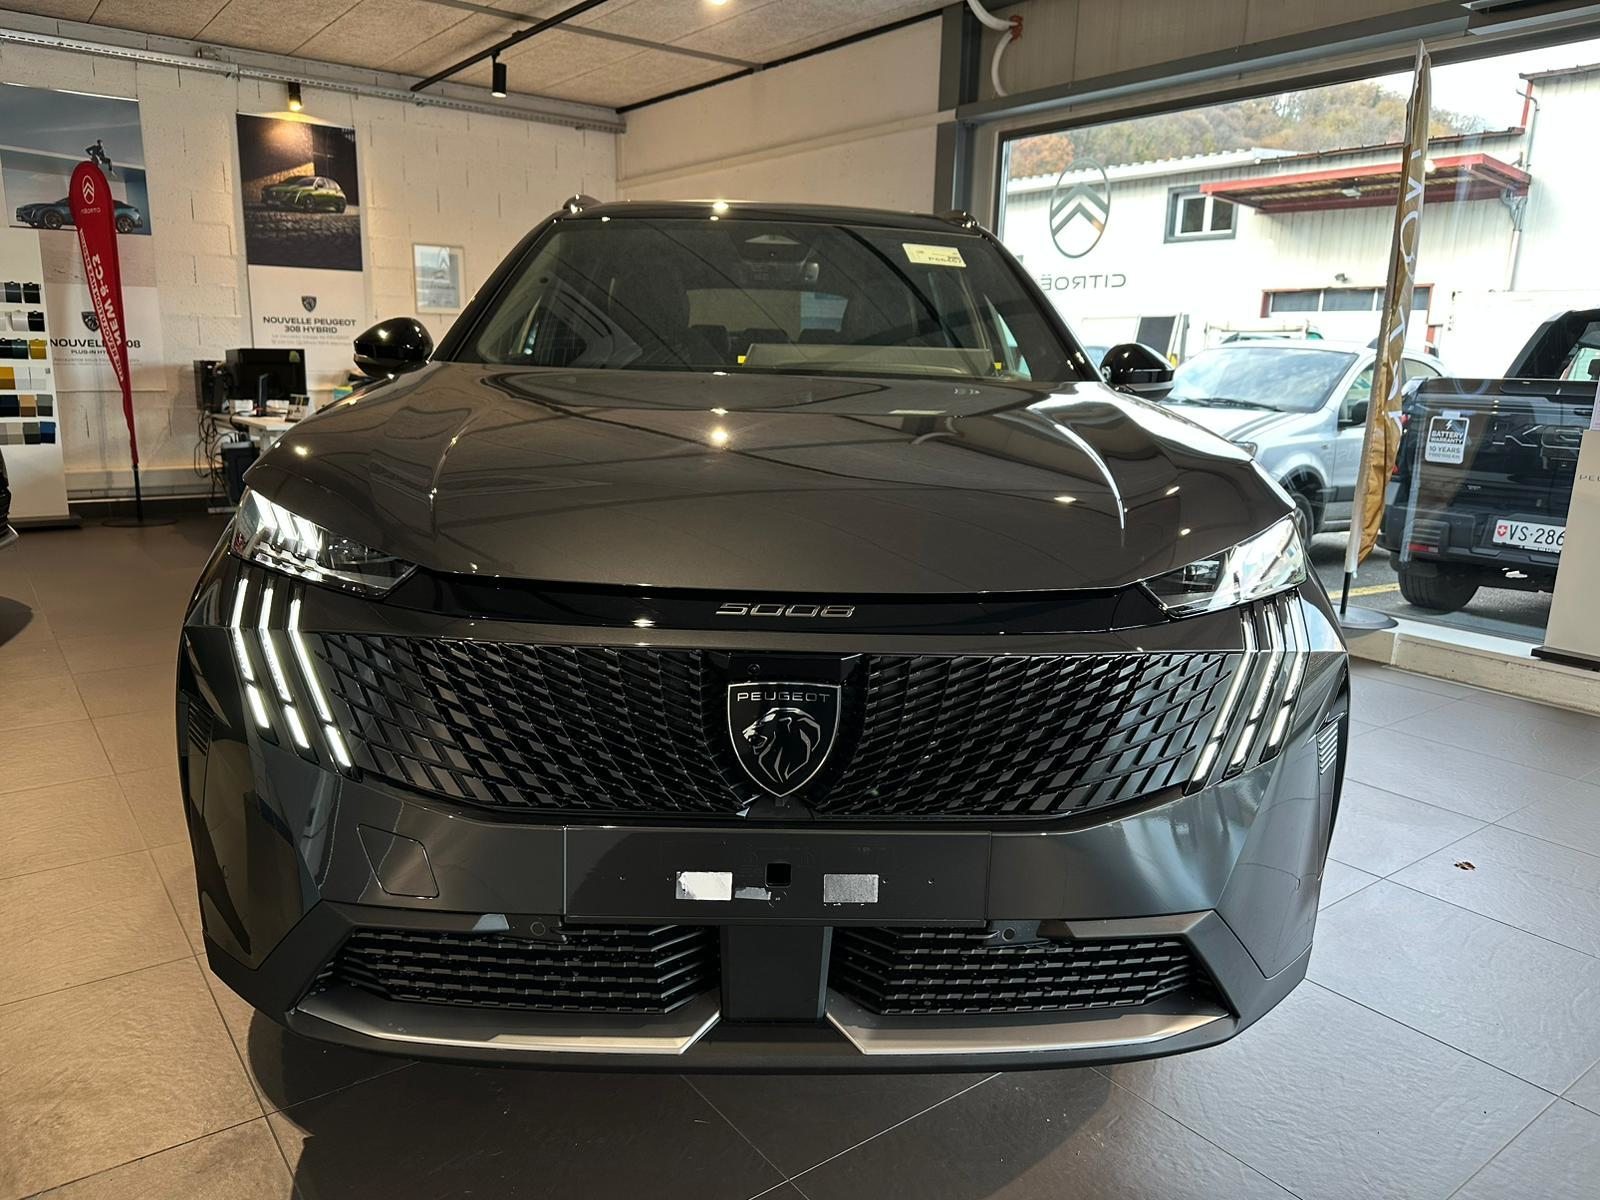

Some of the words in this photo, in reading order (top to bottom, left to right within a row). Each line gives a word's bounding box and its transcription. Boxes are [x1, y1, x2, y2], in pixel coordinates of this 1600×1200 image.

[263, 316, 312, 325] NOUVELLE
[314, 318, 357, 327] PEUGEOT
[285, 325, 301, 333] 308
[303, 326, 338, 334] HYBRID
[50, 338, 106, 348] NOUVELL
[126, 339, 141, 348] 08
[1431, 430, 1464, 439] BATTERY
[715, 602, 856, 618] 5008
[737, 691, 831, 703] PEUGEOT
